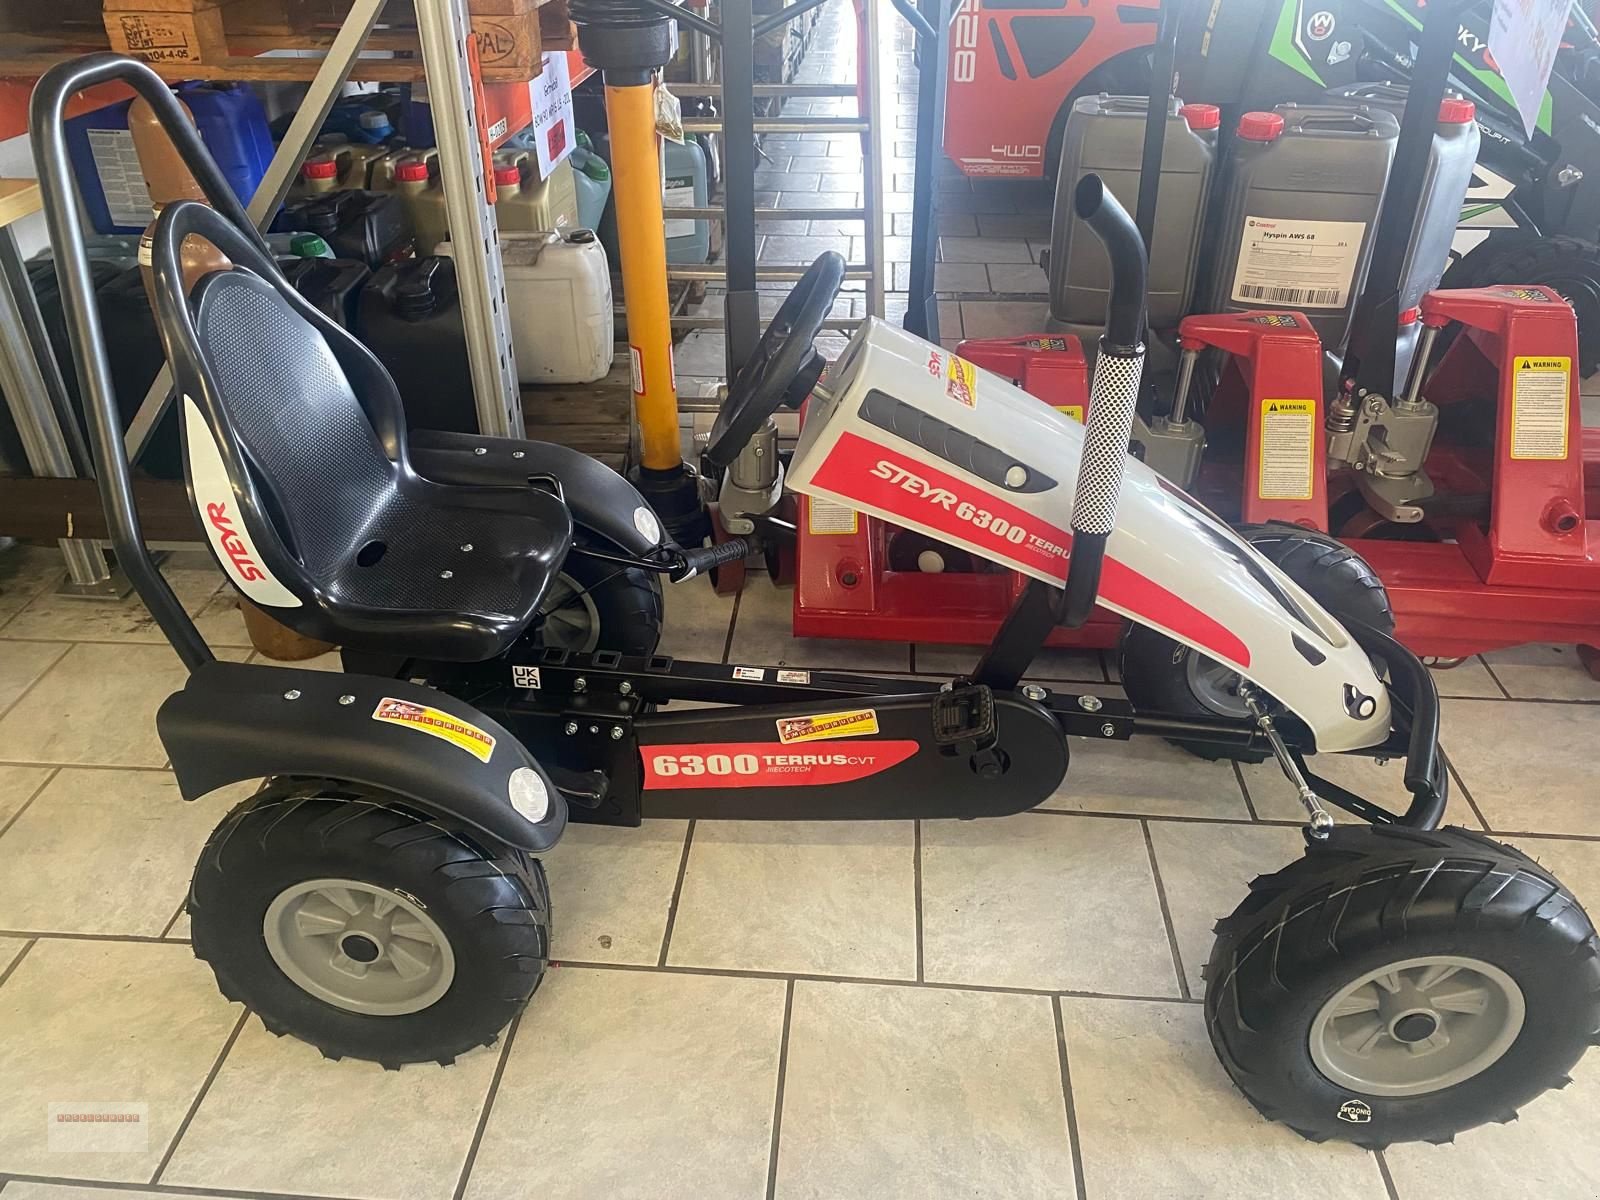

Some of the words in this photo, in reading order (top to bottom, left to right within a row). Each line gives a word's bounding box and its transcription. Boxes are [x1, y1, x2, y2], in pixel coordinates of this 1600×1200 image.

[1263, 231, 1287, 240] Hyspin
[869, 460, 958, 511] STEYR
[955, 501, 1027, 544] 6300
[1029, 534, 1071, 560] TERRU
[207, 502, 267, 581] STEYR
[515, 667, 538, 678] UK
[515, 677, 539, 688] CA
[653, 754, 759, 777] 6300
